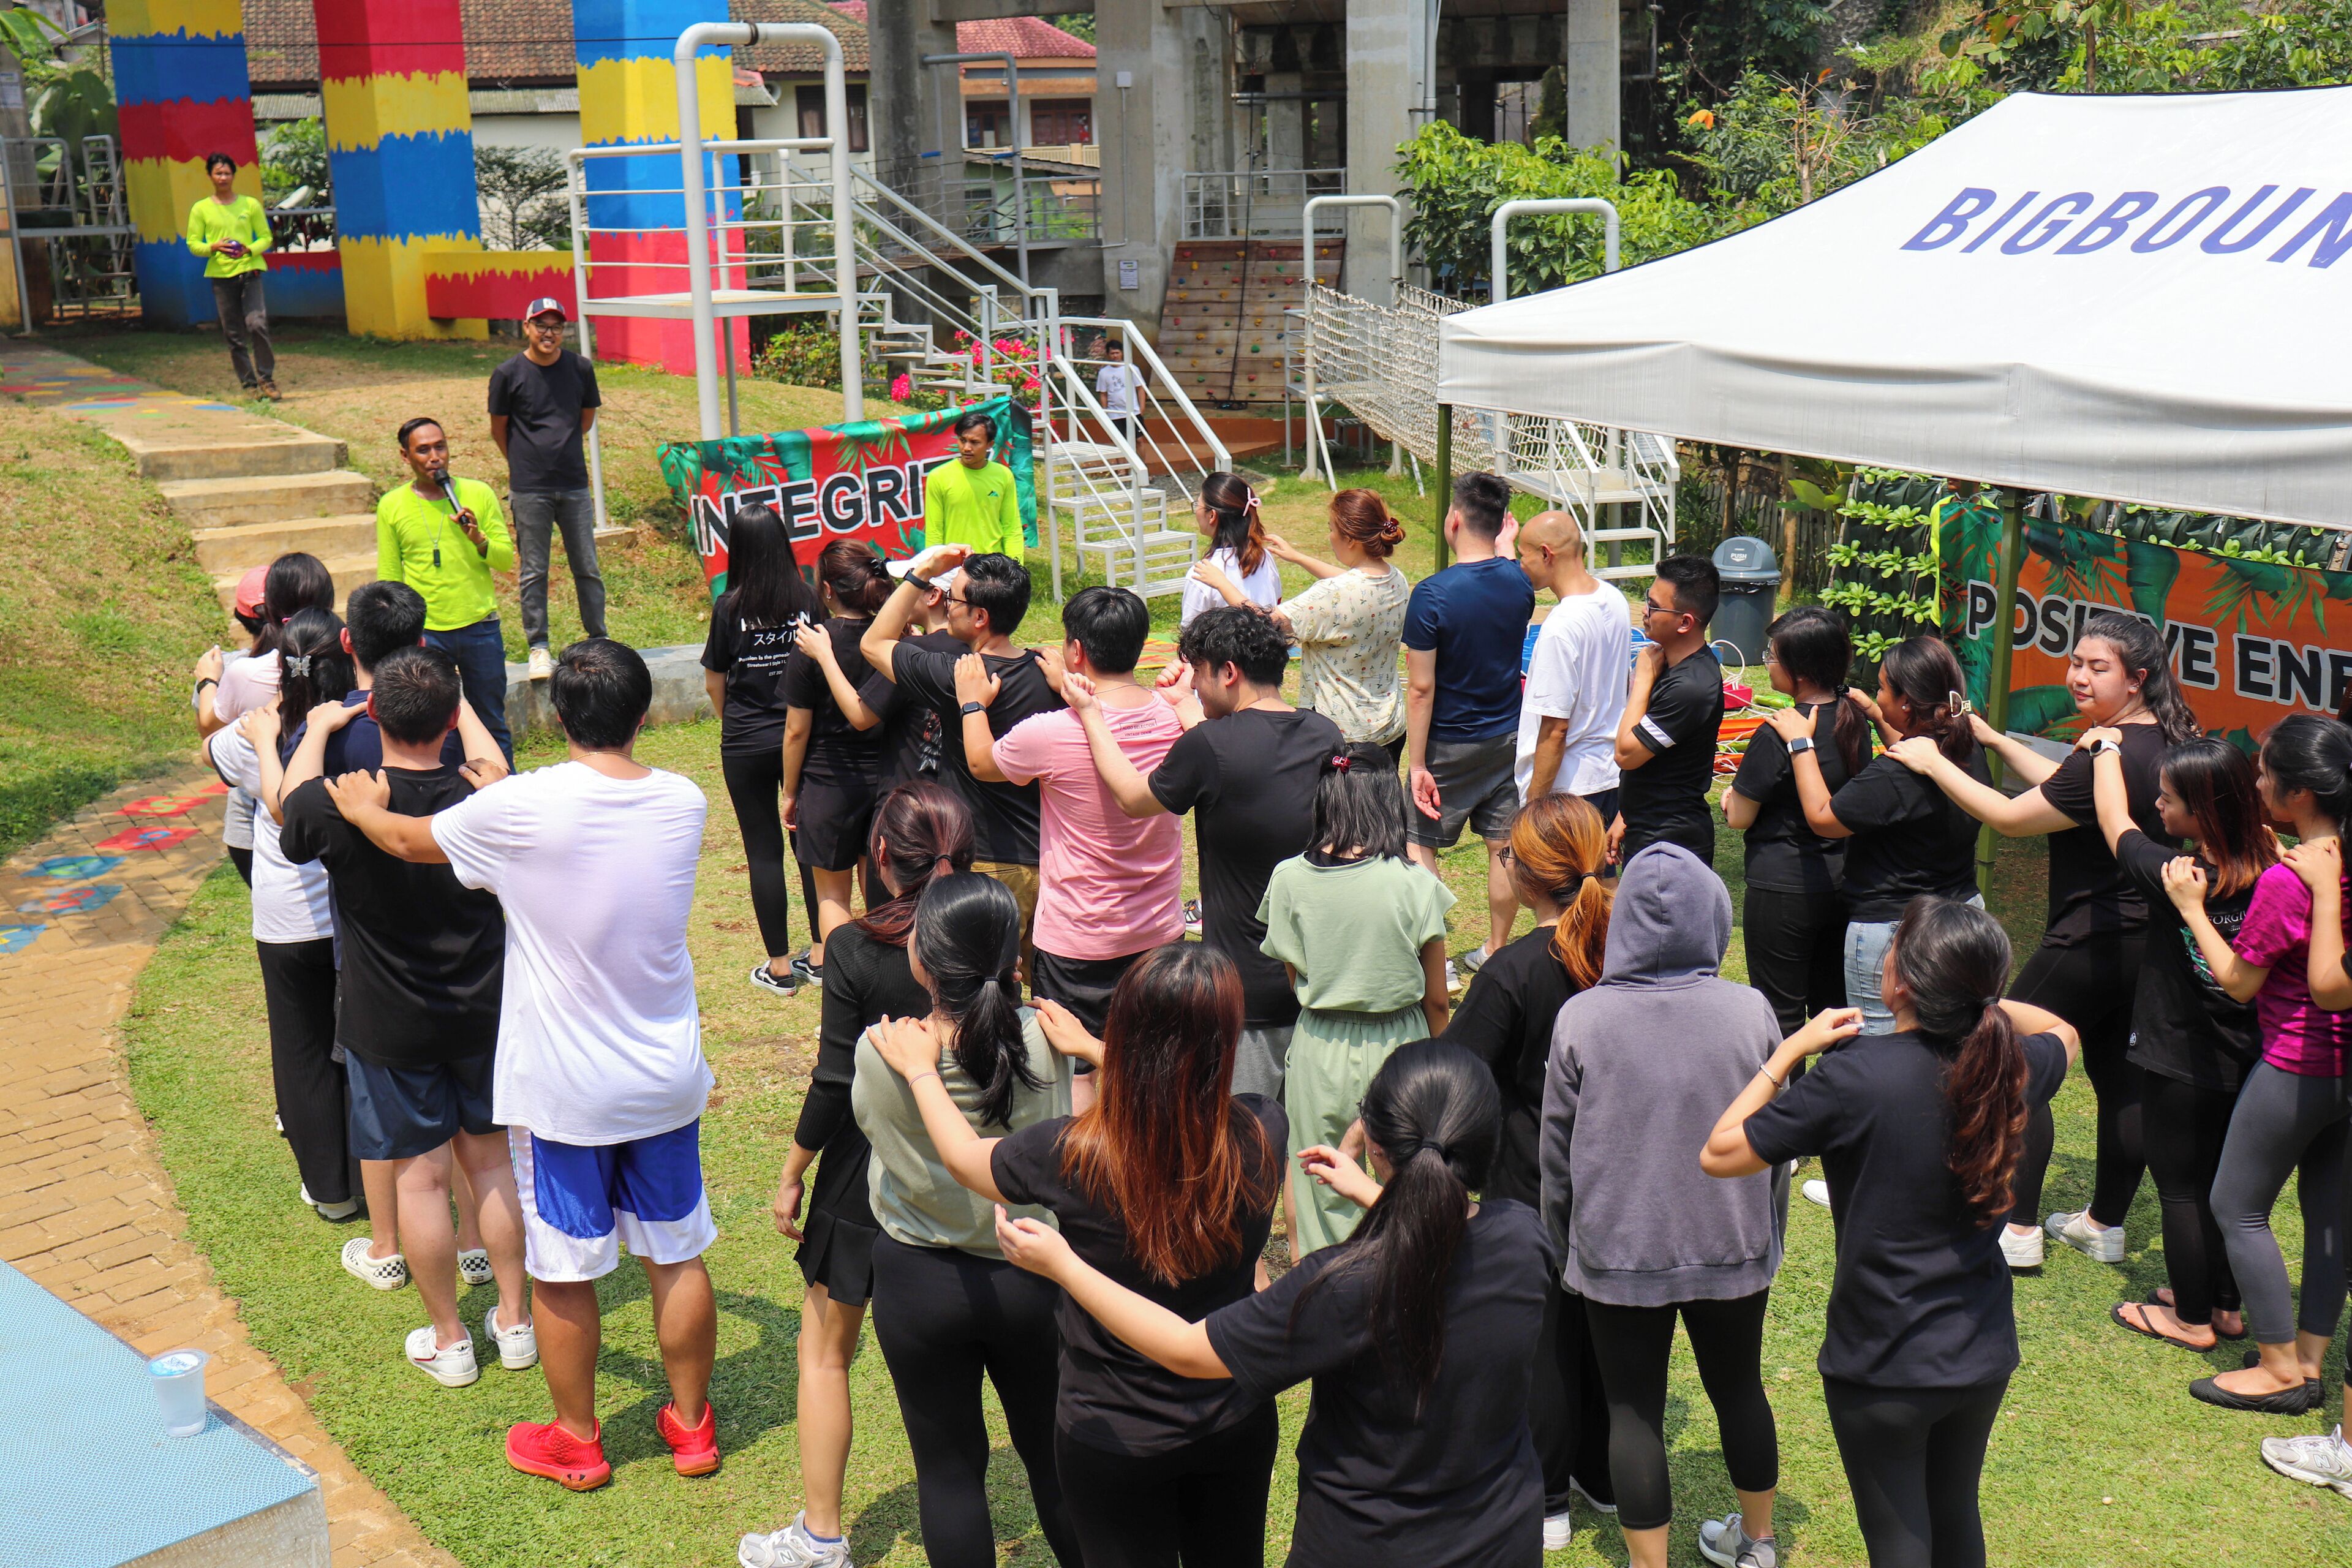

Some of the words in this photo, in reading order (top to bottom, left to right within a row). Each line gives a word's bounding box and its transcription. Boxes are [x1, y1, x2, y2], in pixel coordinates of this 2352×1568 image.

[1899, 184, 2352, 269] BIGBOUN
[692, 450, 993, 555] INEGRI
[1967, 581, 2218, 687] POSIE
